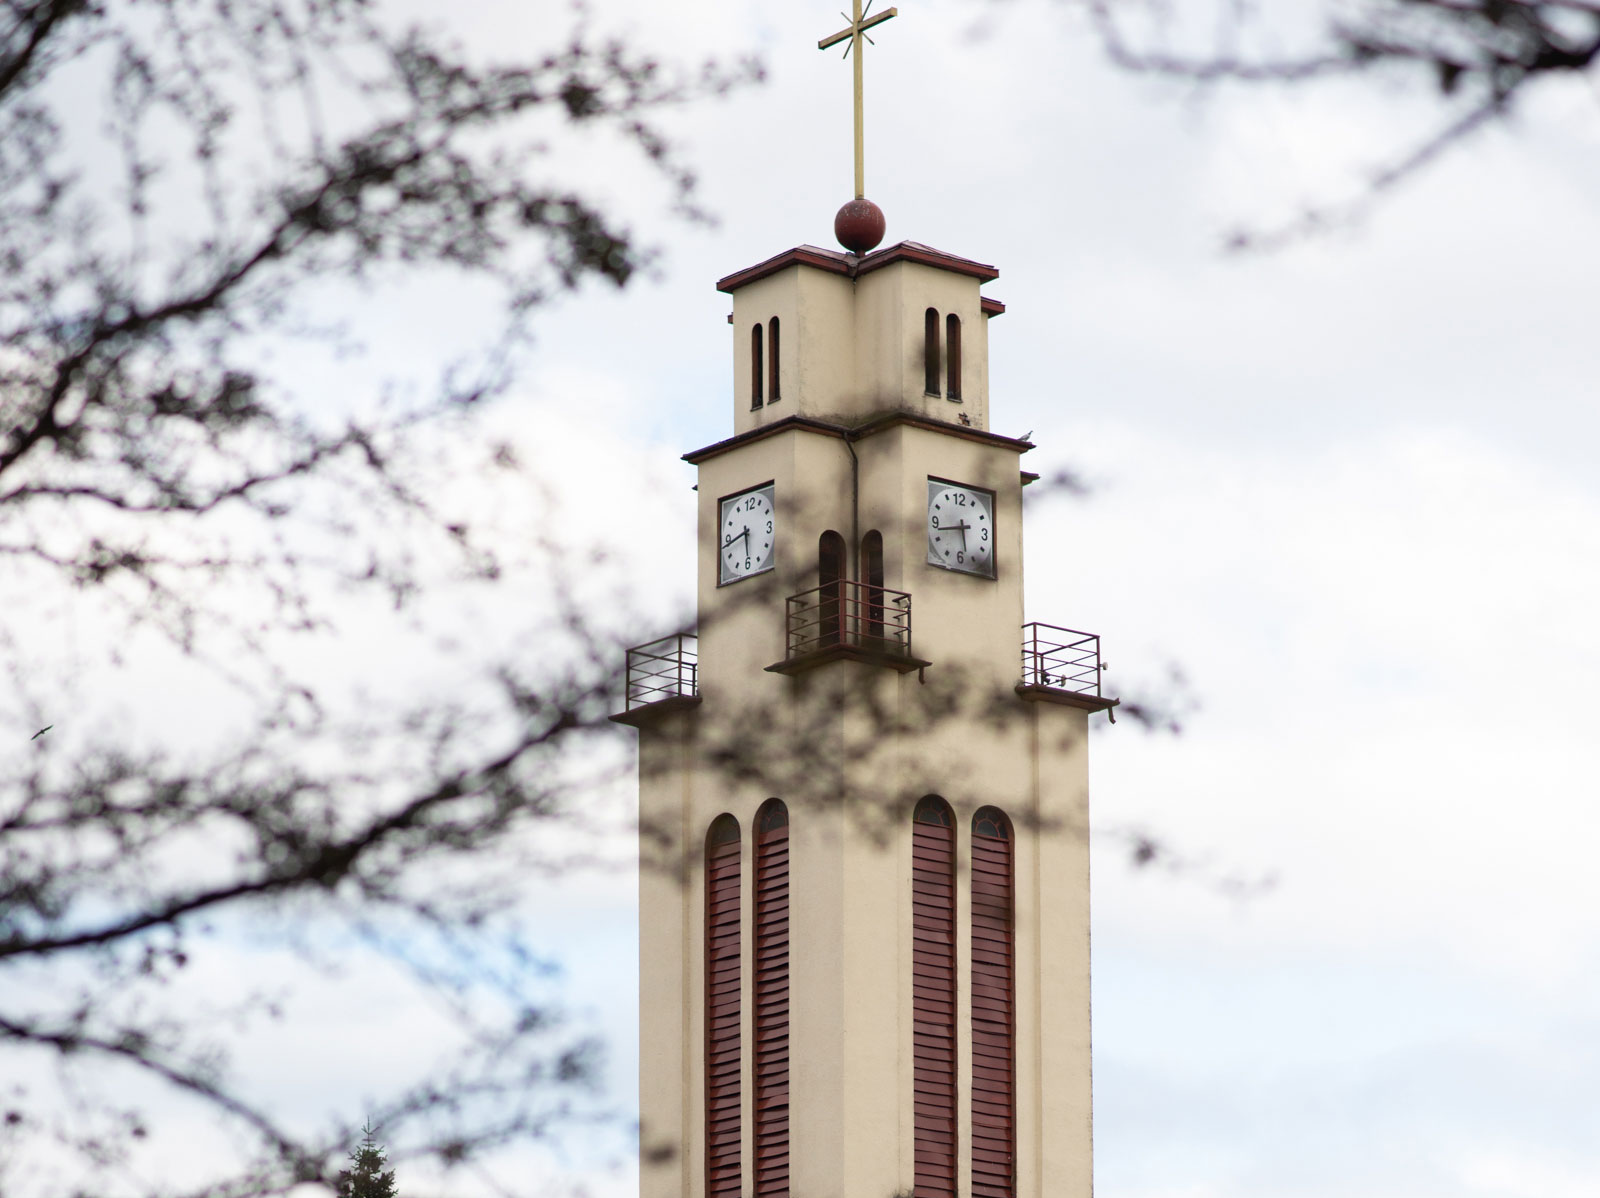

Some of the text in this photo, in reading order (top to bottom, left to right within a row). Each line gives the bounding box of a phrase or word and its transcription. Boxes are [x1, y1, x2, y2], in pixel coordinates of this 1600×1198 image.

[744, 497, 756, 512] 12
[953, 493, 966, 507] 12
[766, 520, 773, 534] 3
[931, 515, 939, 529] 9
[981, 528, 988, 541] 3
[744, 556, 751, 570] 6
[957, 551, 964, 564] 6
